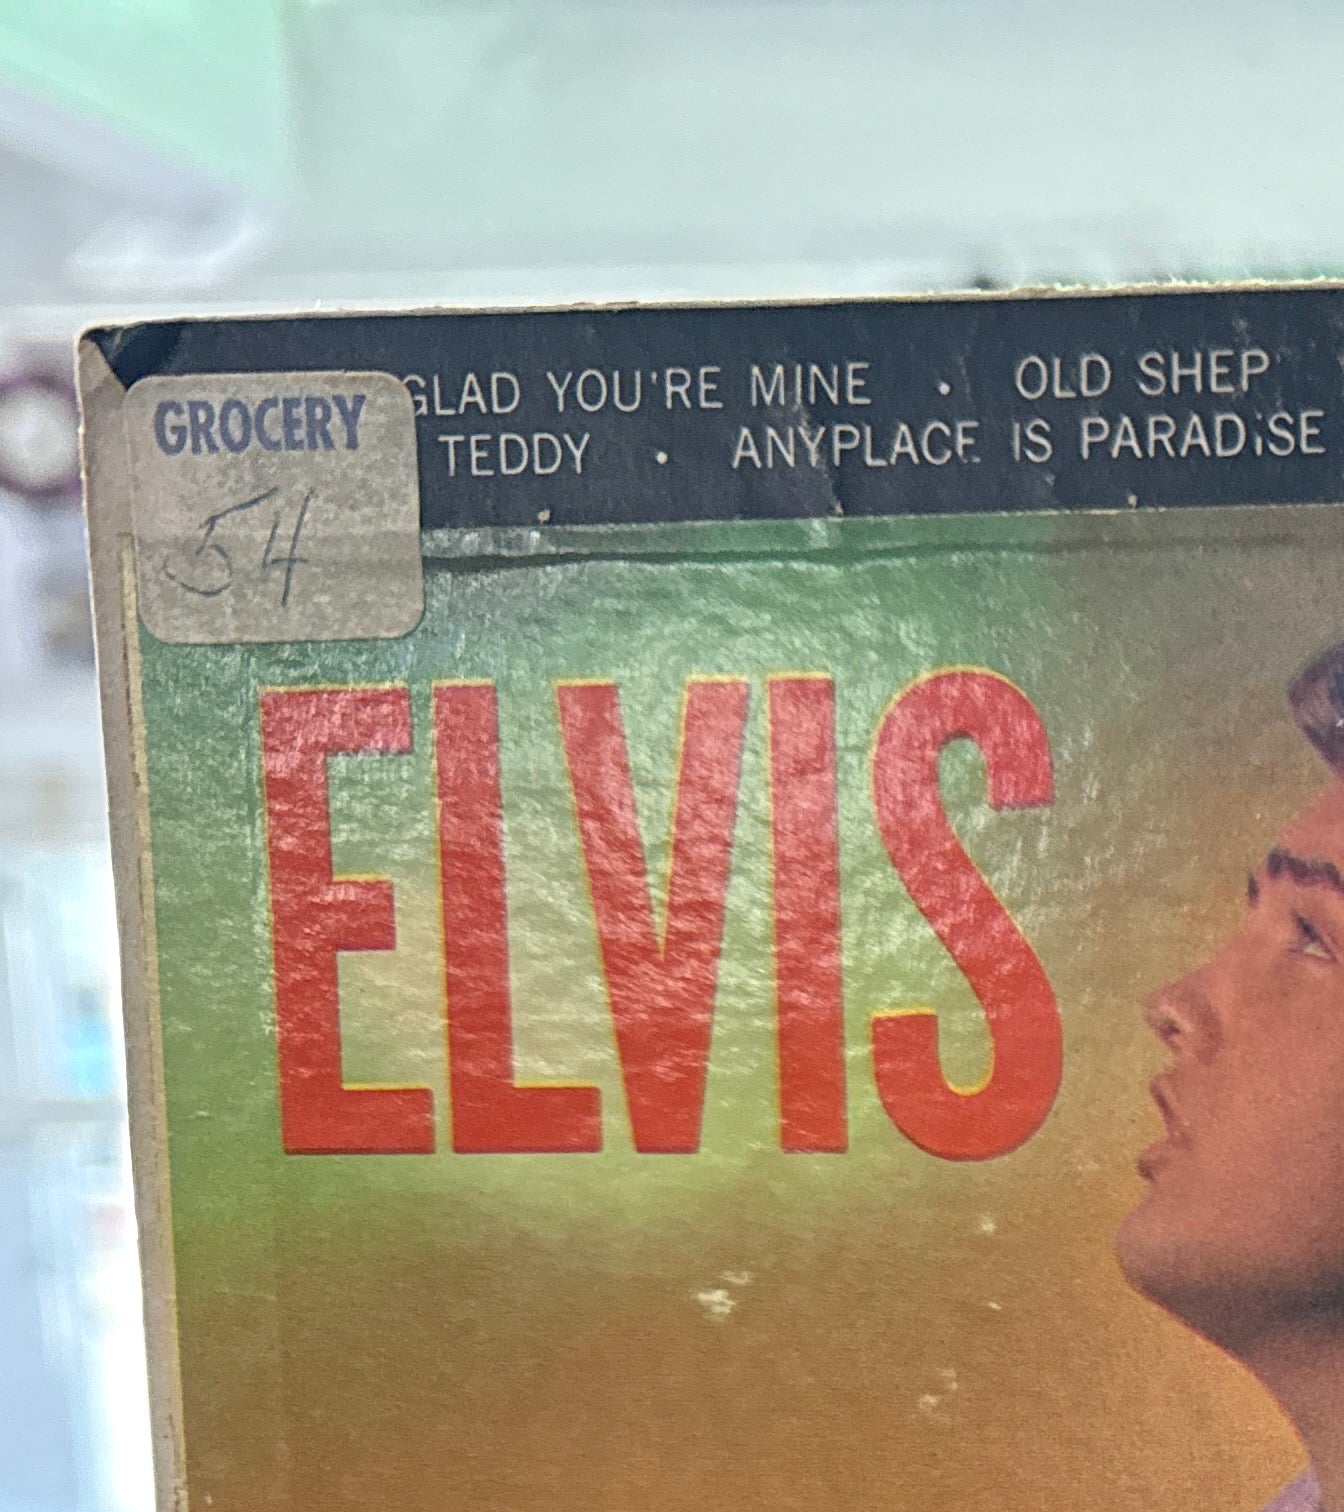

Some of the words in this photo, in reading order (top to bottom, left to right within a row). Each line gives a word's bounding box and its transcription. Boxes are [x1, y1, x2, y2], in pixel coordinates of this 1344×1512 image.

[546, 365, 724, 413] YOU'RE
[751, 362, 872, 408] MINE
[1015, 353, 1112, 400] OLD
[1138, 348, 1271, 398] SHEP
[152, 393, 367, 458] GROCERY
[437, 432, 591, 477] TEDDY
[731, 421, 982, 469] ANYPLACE
[1012, 418, 1054, 463] IS
[1081, 410, 1327, 460] PARADISE
[257, 665, 1064, 1162] ELVIS
